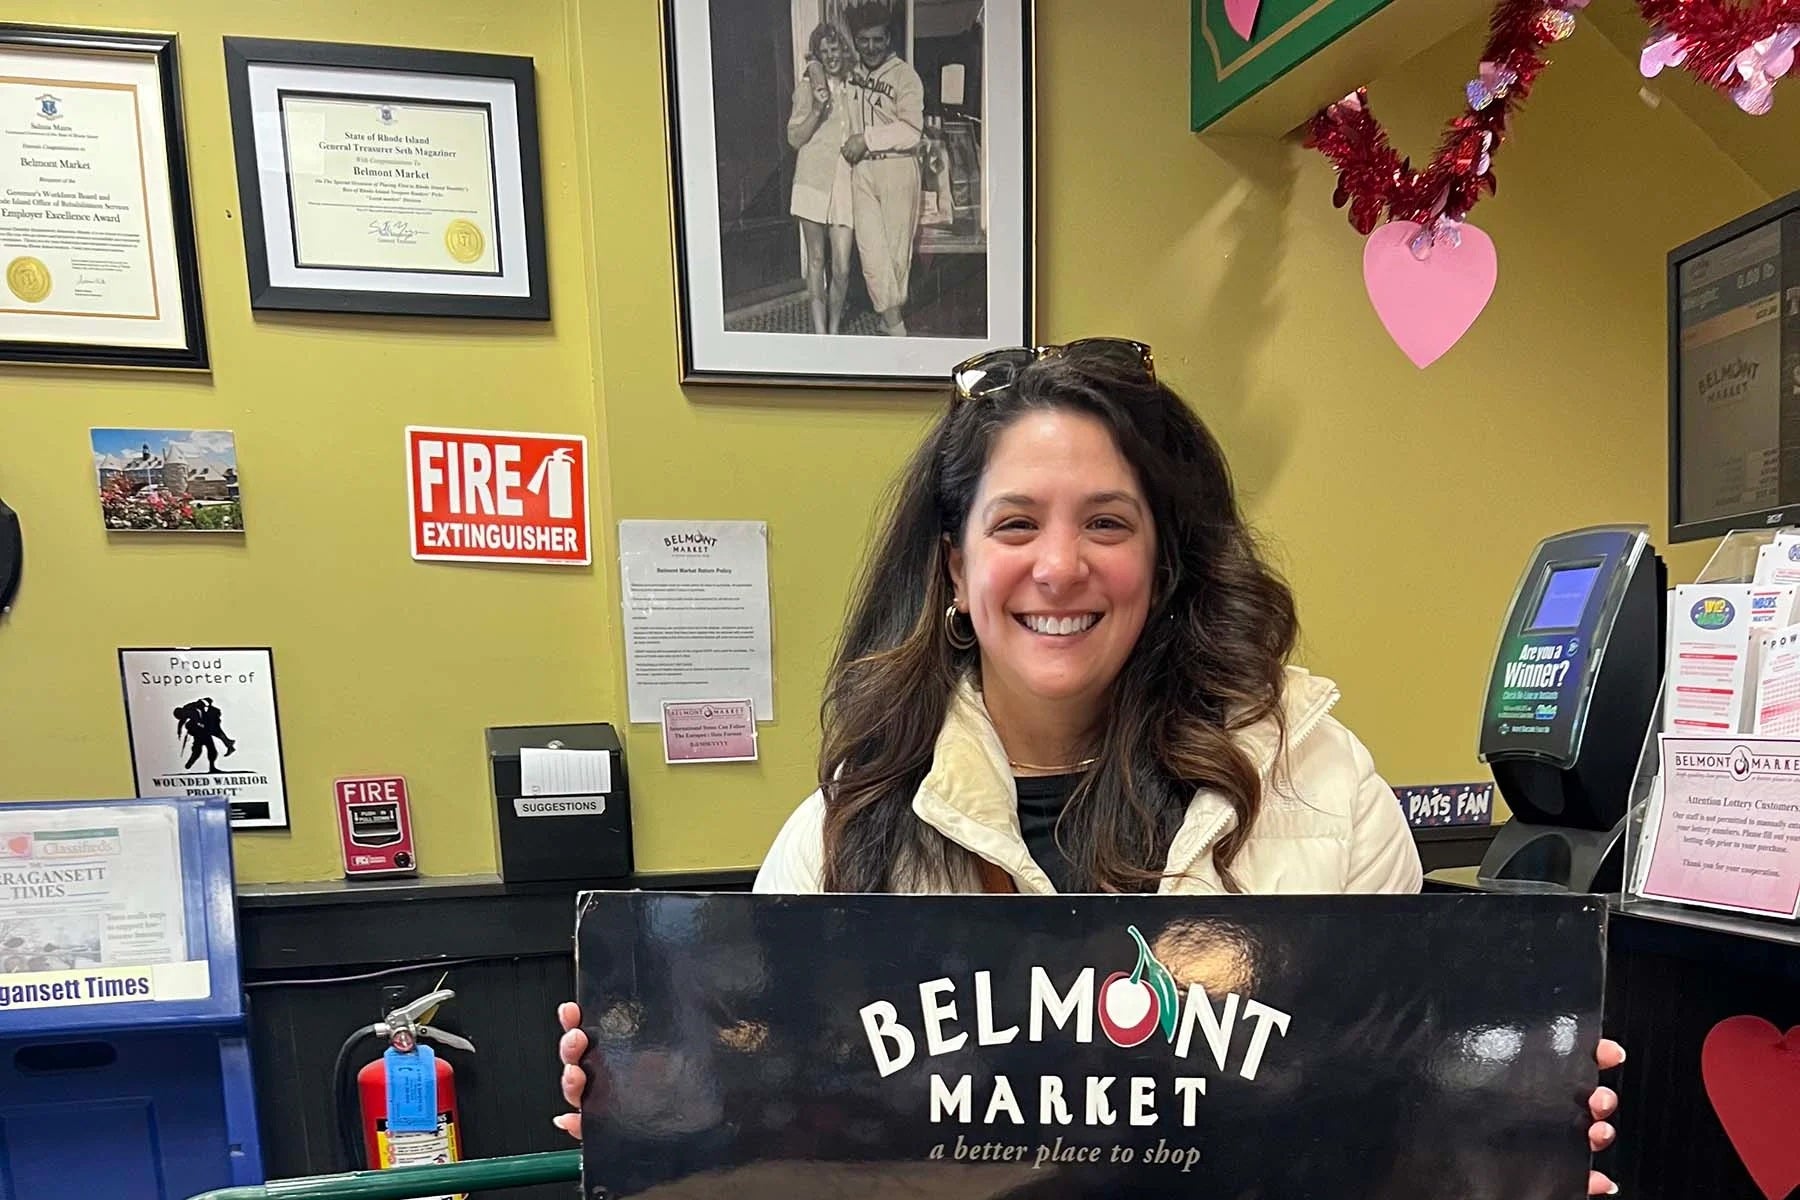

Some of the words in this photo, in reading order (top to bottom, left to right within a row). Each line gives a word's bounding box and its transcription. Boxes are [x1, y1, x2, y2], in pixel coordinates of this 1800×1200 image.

[344, 132, 365, 141] State
[377, 134, 403, 143] Rhode
[405, 136, 430, 145] Island
[319, 142, 351, 151] General
[354, 143, 393, 153] Treasurer
[395, 146, 413, 155] Seth
[415, 147, 457, 158] Magaziner
[20, 157, 58, 168] Belmont
[60, 159, 91, 170] Market
[353, 166, 393, 177] Belmont
[395, 168, 430, 179] Market
[32, 199, 51, 207] Office
[1, 207, 42, 219] Employer
[45, 209, 91, 221] Excellence
[93, 213, 121, 222] Award
[418, 440, 524, 517] FIRE
[422, 521, 579, 552] EXTINGUISHER
[663, 531, 718, 547] BELMONT
[1519, 644, 1538, 660] Are
[1536, 645, 1555, 662] you
[170, 657, 222, 670] Proud
[141, 672, 232, 686] Supporter
[238, 671, 255, 684] of
[1503, 660, 1570, 688] Winner?
[1675, 755, 1731, 767] BELMONT
[1751, 758, 1800, 771] MARKE
[152, 777, 210, 787] WOUNDED
[214, 775, 268, 786] WARRIOR
[186, 787, 238, 796] PROJECT
[343, 781, 398, 803] FIRE
[522, 801, 597, 812] SUGGESTIONS
[1409, 793, 1451, 821] PATS
[1457, 790, 1490, 817] FAN
[1688, 796, 1721, 806] Attention
[1723, 797, 1752, 811] Lottery
[43, 839, 113, 855] Classifieds
[1683, 858, 1701, 867] Thank
[12, 884, 66, 900] TIMES
[0, 979, 80, 1006] gansett
[85, 976, 149, 998] Times
[859, 955, 1292, 1081] BELMONT
[930, 1073, 1206, 1127] MARKET
[930, 1143, 944, 1160] a
[954, 1136, 1027, 1161] better
[1032, 1137, 1101, 1169] place
[1110, 1144, 1135, 1163] to
[1143, 1139, 1201, 1172] shop
